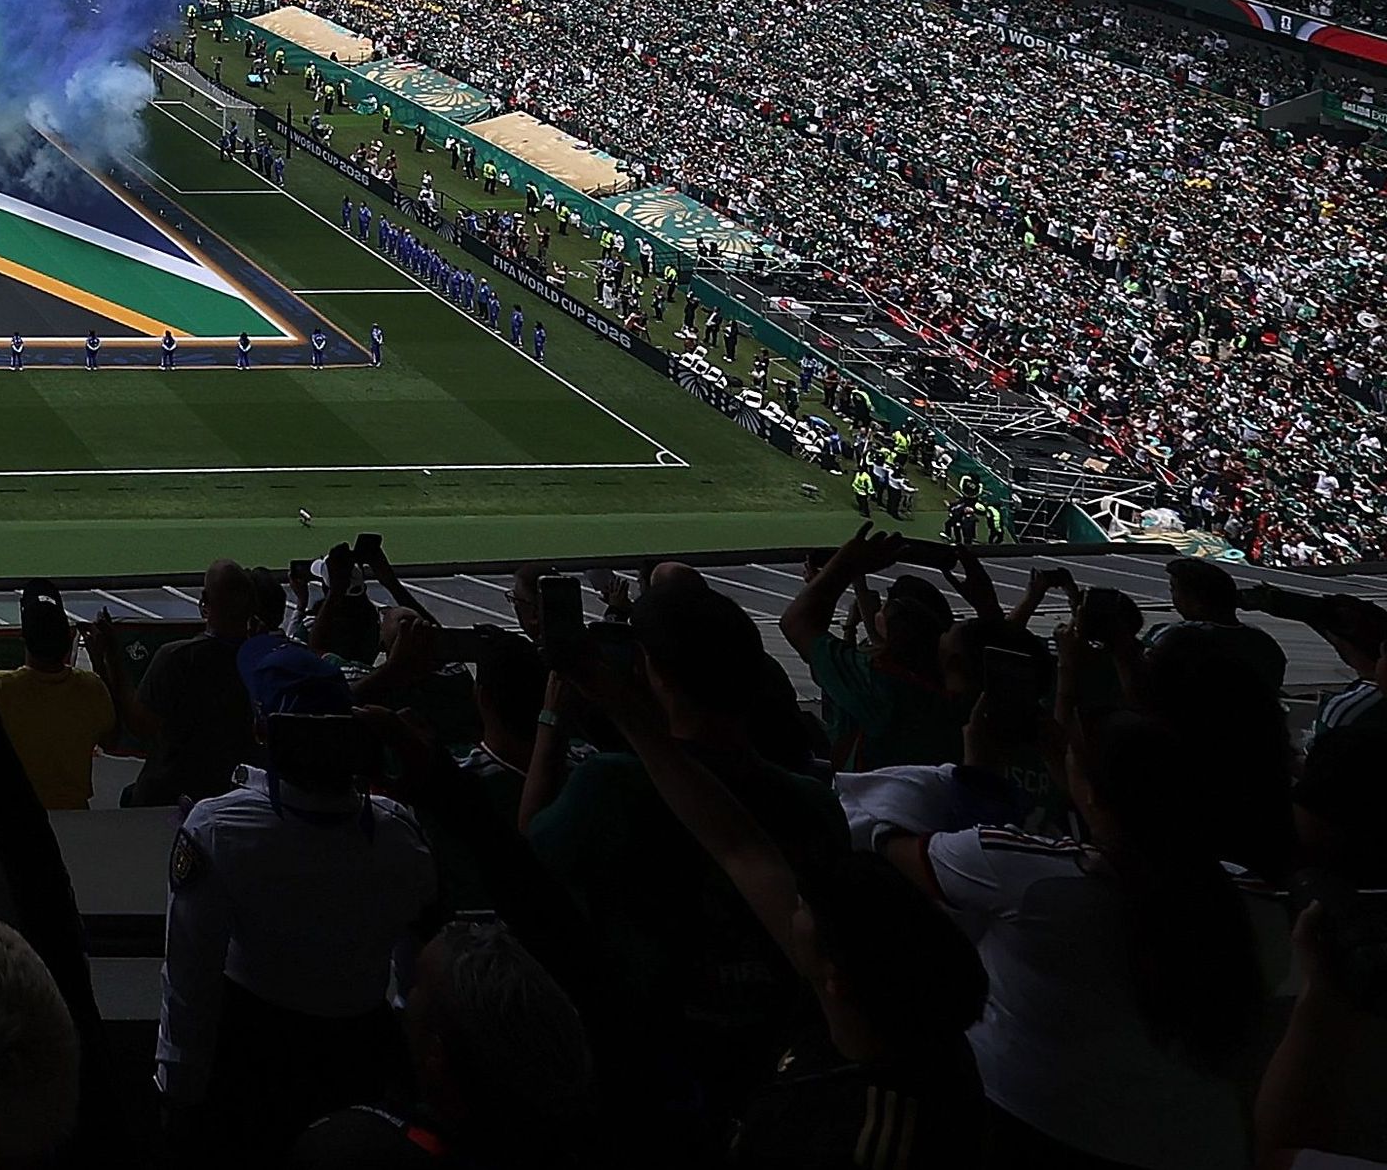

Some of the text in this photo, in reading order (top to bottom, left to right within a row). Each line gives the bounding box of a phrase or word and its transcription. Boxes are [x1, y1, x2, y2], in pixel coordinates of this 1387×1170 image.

[293, 132, 371, 187] WORLD CUP 2026
[493, 255, 632, 350] FIFA WORLD CUP 2026
